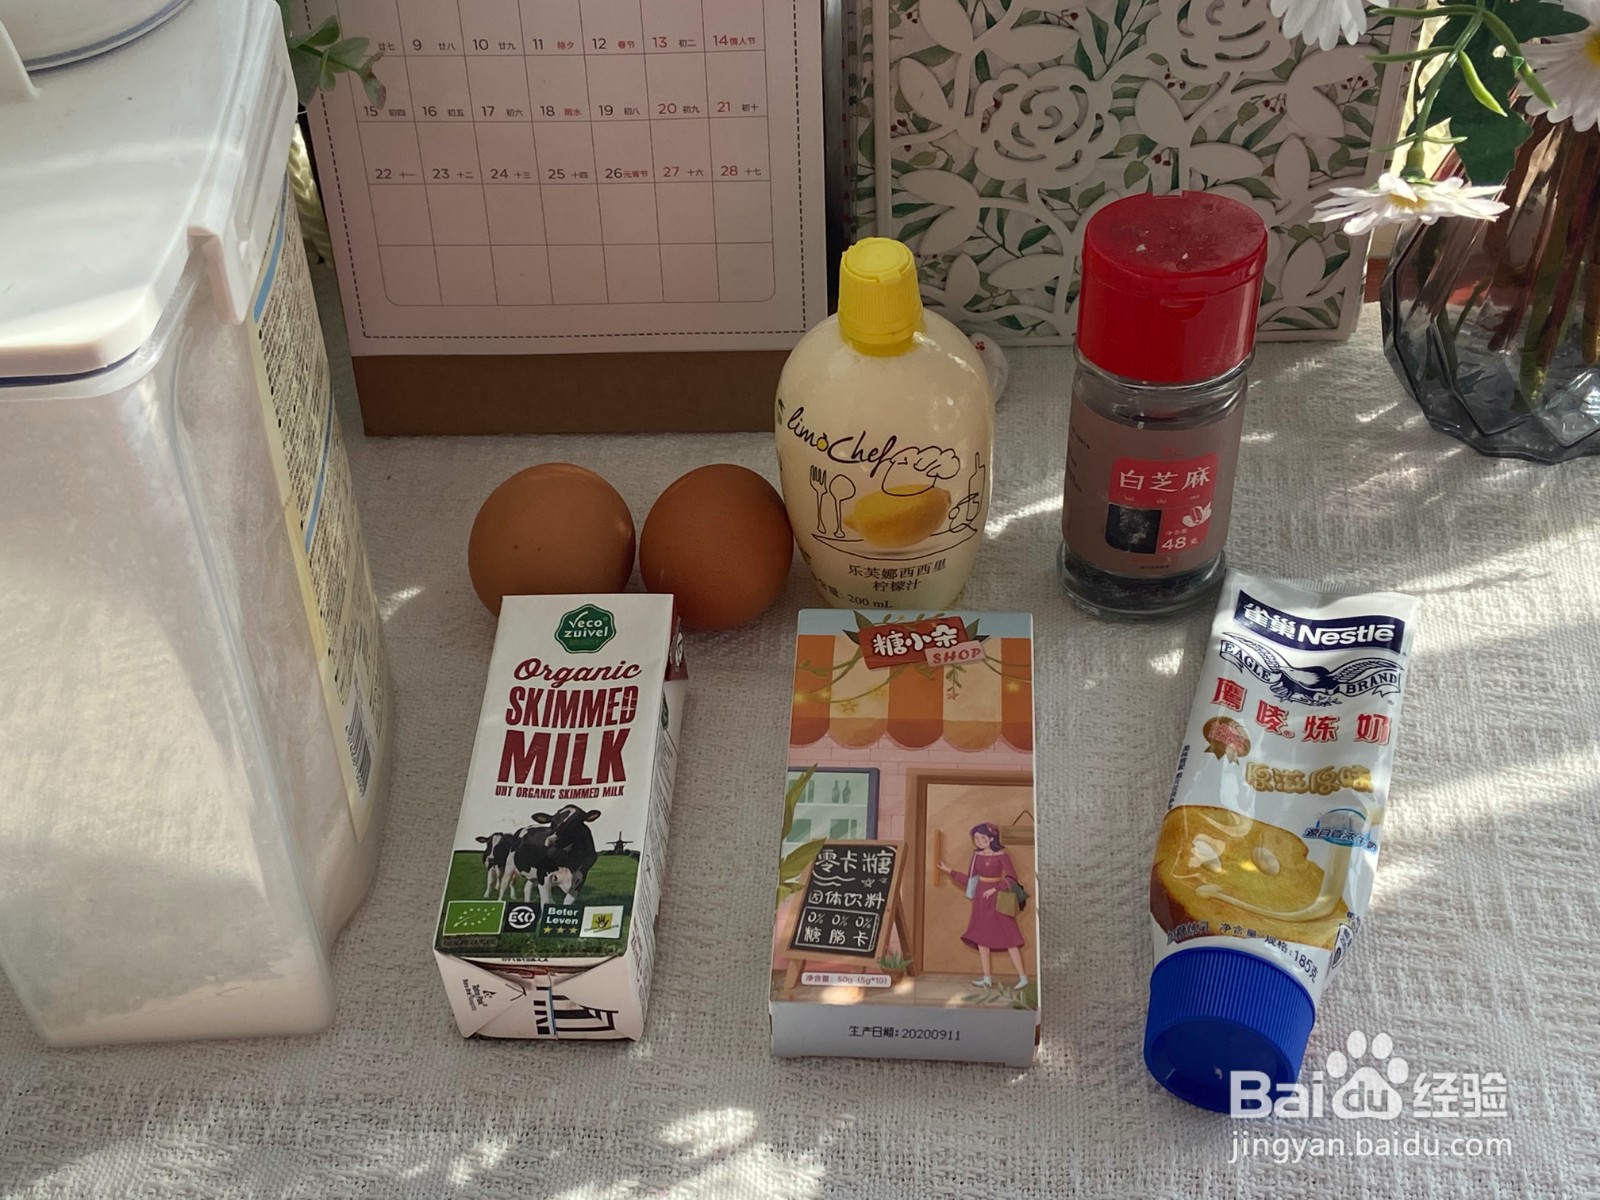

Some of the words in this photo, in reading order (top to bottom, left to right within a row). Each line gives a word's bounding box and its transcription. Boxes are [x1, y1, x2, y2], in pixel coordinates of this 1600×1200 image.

[412, 39, 422, 51] 9
[438, 42, 456, 51] 廿八
[472, 39, 489, 51] 10
[498, 42, 516, 50] 廿九
[532, 38, 544, 50] 11
[557, 41, 574, 49] 除夕
[592, 38, 607, 50] 12
[618, 40, 635, 49] 春节
[652, 36, 668, 48] 13
[678, 39, 696, 48] 初二
[713, 34, 728, 46] 14
[729, 36, 756, 46] 情人节
[364, 105, 379, 117] 15
[422, 105, 437, 117] 16
[447, 108, 464, 117] 初五
[481, 105, 494, 117] 17
[506, 108, 524, 117] 初六
[540, 105, 555, 117] 18
[564, 108, 582, 117] 雨水
[598, 105, 613, 116] 19
[624, 107, 641, 116] 初八
[658, 103, 677, 115] 20
[682, 105, 700, 114] 初九
[717, 101, 731, 113] 21
[741, 103, 759, 112] 初十
[375, 168, 392, 179] 22
[432, 168, 450, 179] 23
[456, 171, 474, 179] 十二
[491, 168, 508, 179] 24
[513, 171, 531, 179] 十三
[548, 168, 566, 179] 25
[605, 168, 622, 179] 26
[623, 170, 649, 178] 元宵节
[663, 167, 680, 178] 27
[687, 168, 704, 177] 十六
[720, 165, 739, 177] 28
[744, 168, 762, 176] 十七
[1119, 465, 1211, 493] 白芝麻
[1161, 536, 1187, 550] 48
[848, 558, 946, 580] 乐芙娜西西里
[872, 579, 922, 592] 柠檬汁
[848, 594, 870, 607] 200
[873, 600, 894, 608] mL
[1243, 602, 1296, 640] 雀巢
[563, 626, 609, 638] zuivel
[872, 624, 958, 656] 糖小朵
[932, 647, 981, 664] SHOP
[513, 657, 643, 689] Organic
[1223, 641, 1271, 683] EAGLE
[1345, 672, 1398, 694] BRAND
[505, 684, 639, 729] SKIMMED
[497, 728, 631, 786] MILK
[495, 785, 514, 797] UHT
[516, 786, 556, 800] ORGANIC
[558, 786, 599, 800] SKIMMED
[602, 785, 625, 797] MILK
[815, 849, 894, 875] 零卡糖
[808, 889, 885, 910] 固体饮料
[546, 916, 579, 925] Leven
[547, 907, 579, 917] Beter
[807, 911, 826, 924] 0%
[831, 914, 850, 927] 0%
[855, 916, 873, 929] 0%
